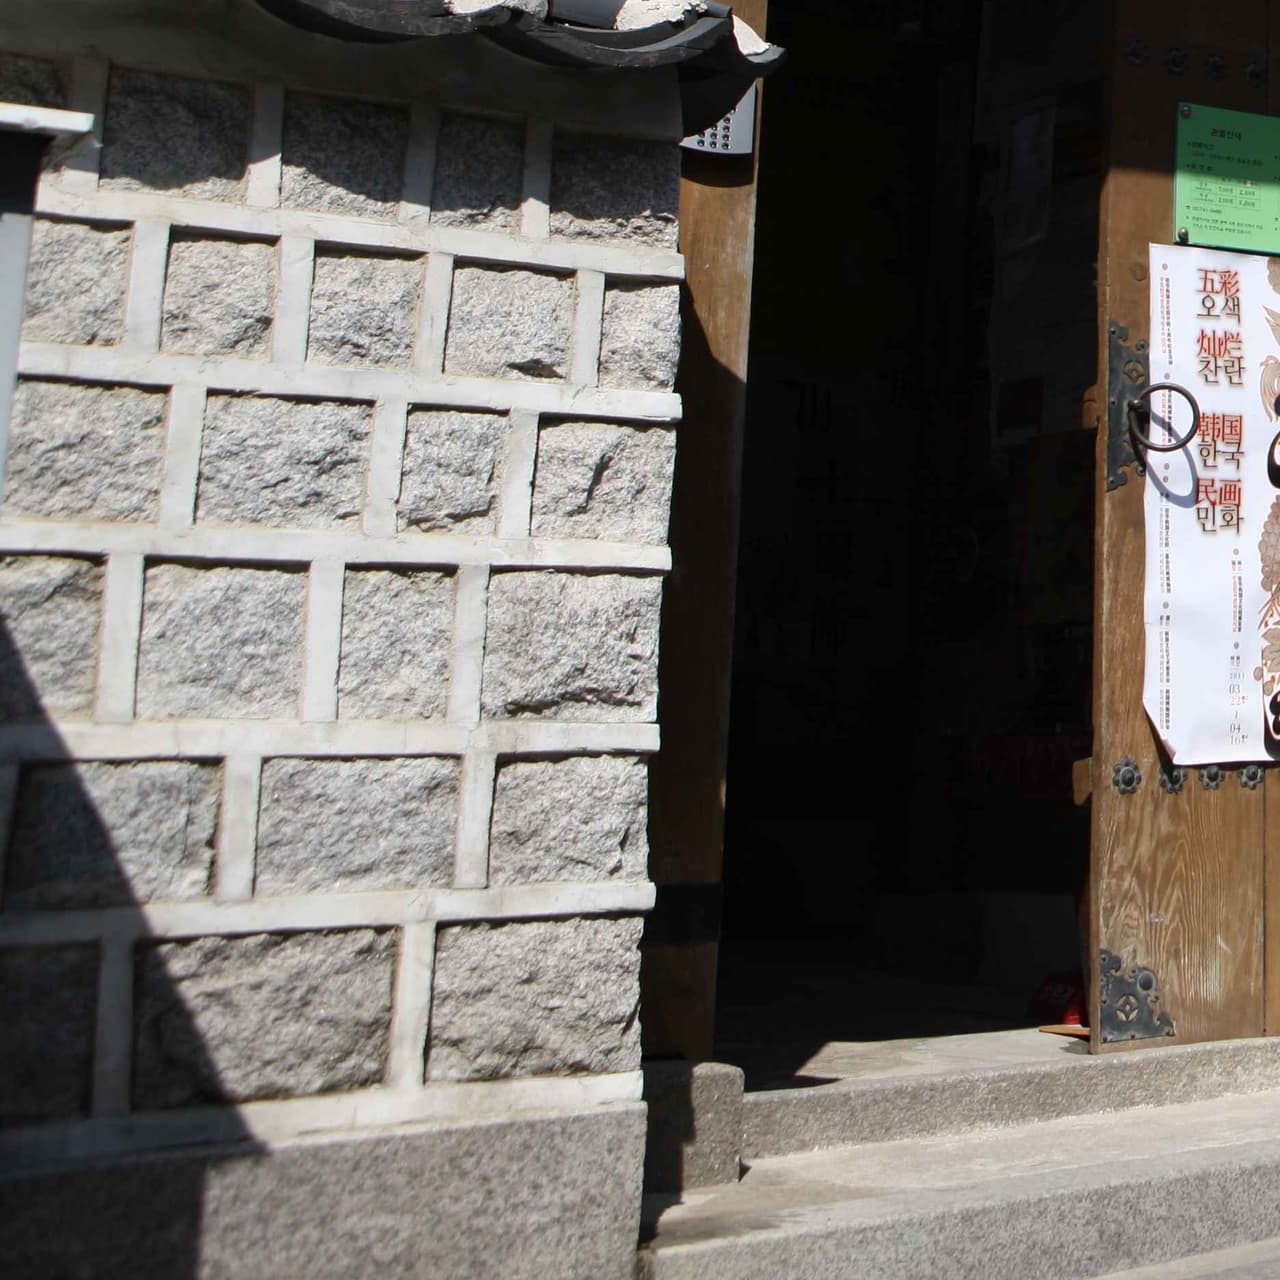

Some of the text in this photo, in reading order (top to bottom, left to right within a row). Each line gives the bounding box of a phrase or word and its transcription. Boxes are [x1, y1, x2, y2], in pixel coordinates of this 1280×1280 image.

[1196, 268, 1240, 297] 五彩
[1197, 295, 1241, 325] 오색
[1197, 328, 1244, 358] 灿烂
[1199, 356, 1246, 385] 찬란
[1197, 412, 1243, 441] 韩国
[1199, 439, 1244, 470] 한국
[1195, 477, 1242, 506] 民画
[1196, 504, 1244, 534] 민화
[1229, 684, 1241, 694] 03
[1229, 723, 1241, 734] 04
